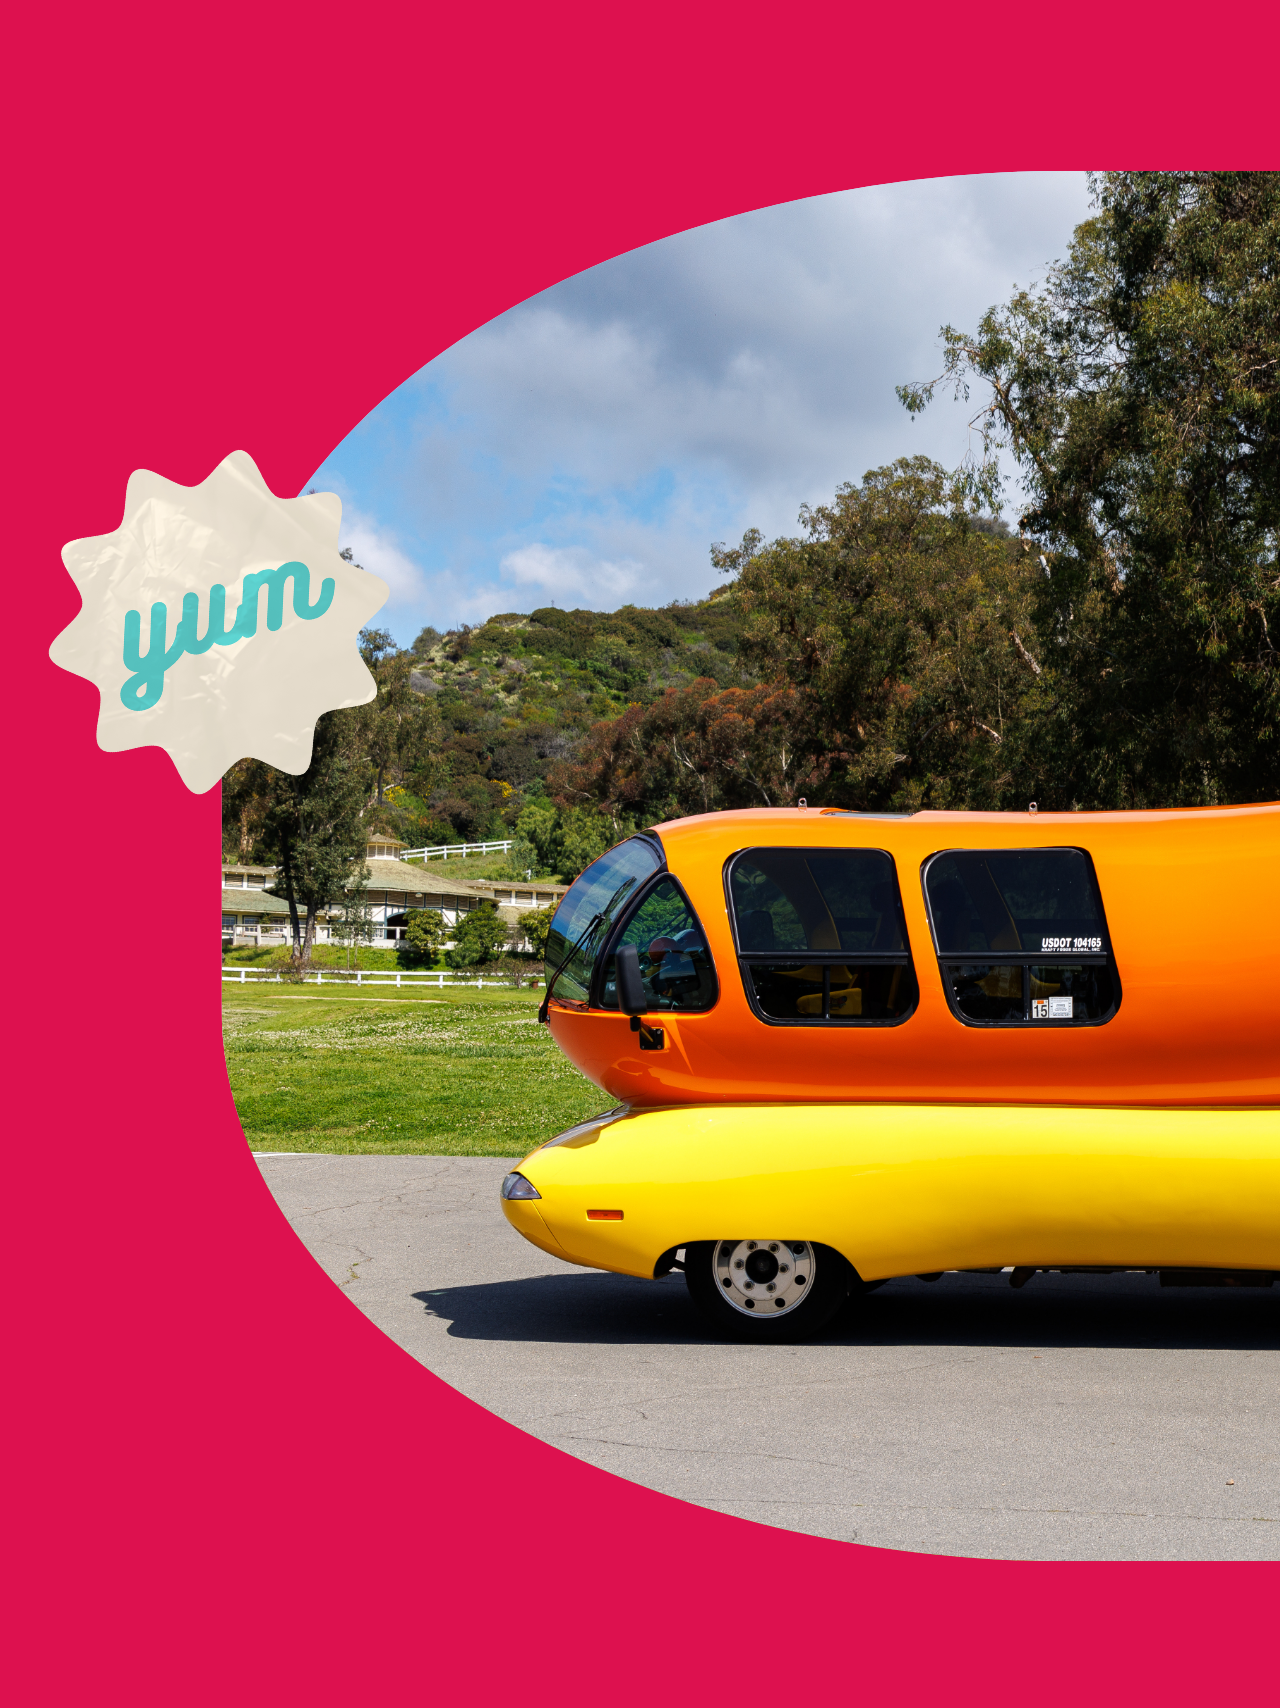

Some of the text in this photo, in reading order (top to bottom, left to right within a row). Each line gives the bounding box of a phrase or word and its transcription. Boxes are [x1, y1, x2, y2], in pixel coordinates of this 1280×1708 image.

[1041, 937, 1101, 948] USDOT 104165
[1034, 1004, 1047, 1018] 15
